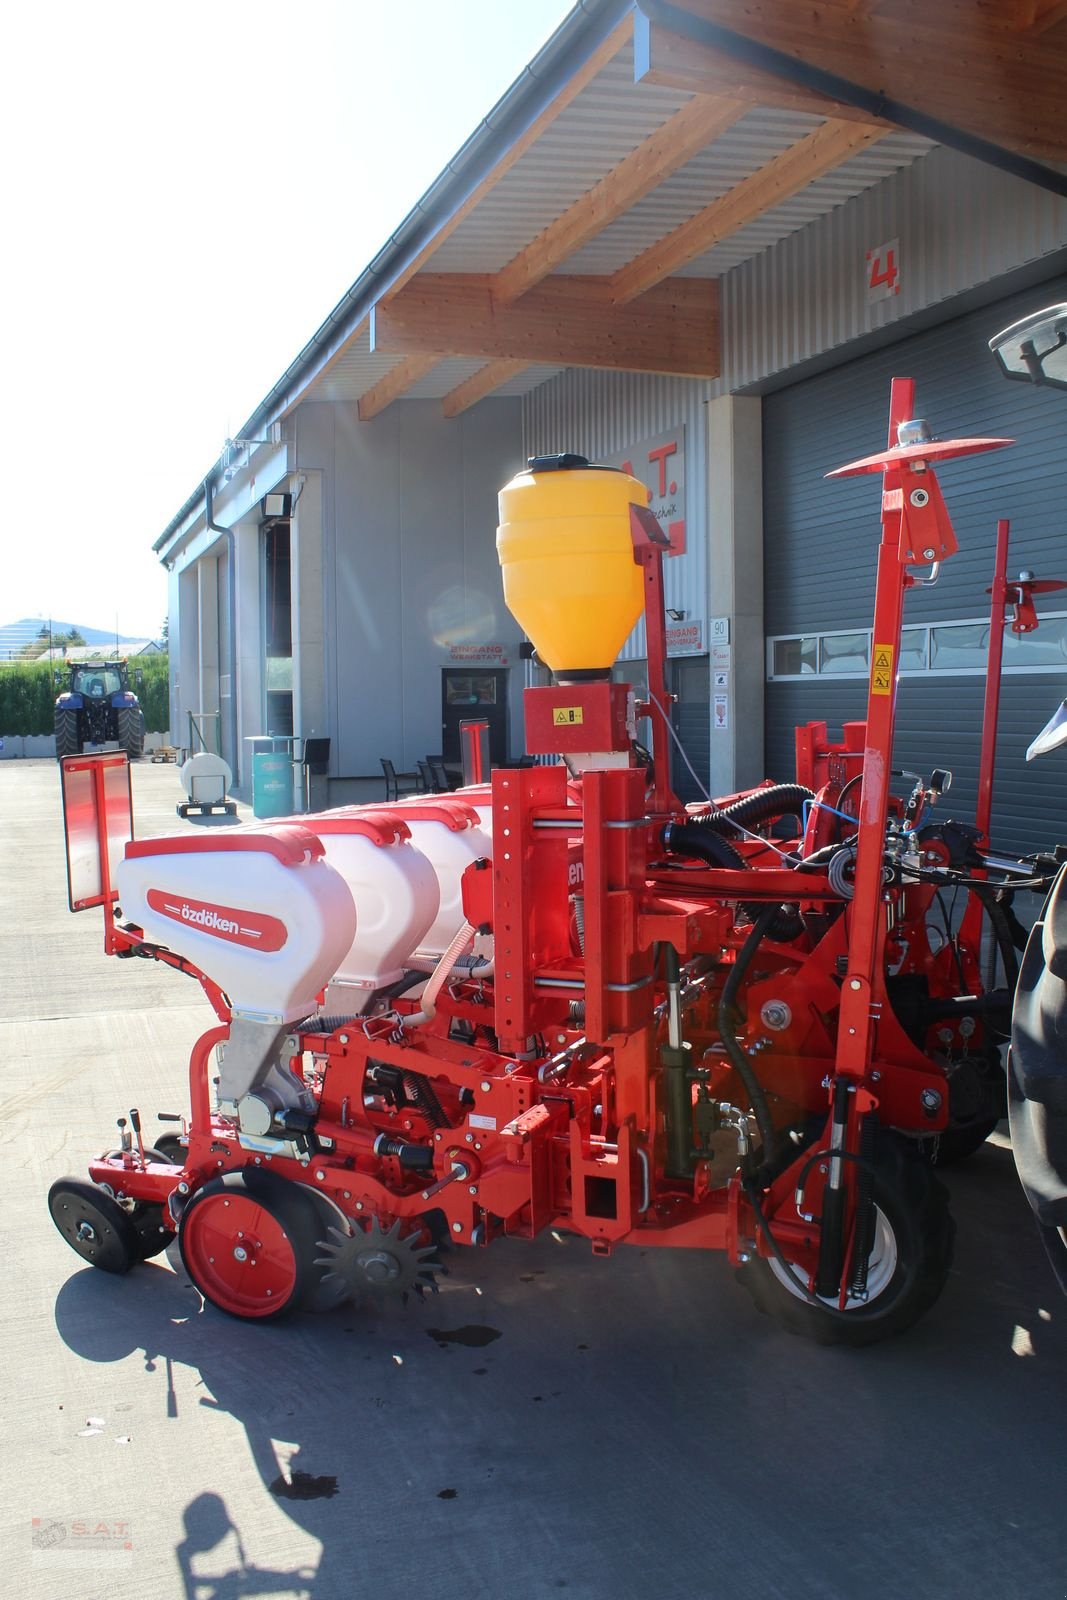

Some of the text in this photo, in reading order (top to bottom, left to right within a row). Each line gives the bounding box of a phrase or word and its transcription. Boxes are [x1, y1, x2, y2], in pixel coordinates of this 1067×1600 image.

[870, 249, 898, 288] 4
[665, 627, 698, 639] EINGANG
[714, 622, 724, 635] 90
[450, 645, 503, 653] EINGANG
[181, 904, 239, 934] özdöken
